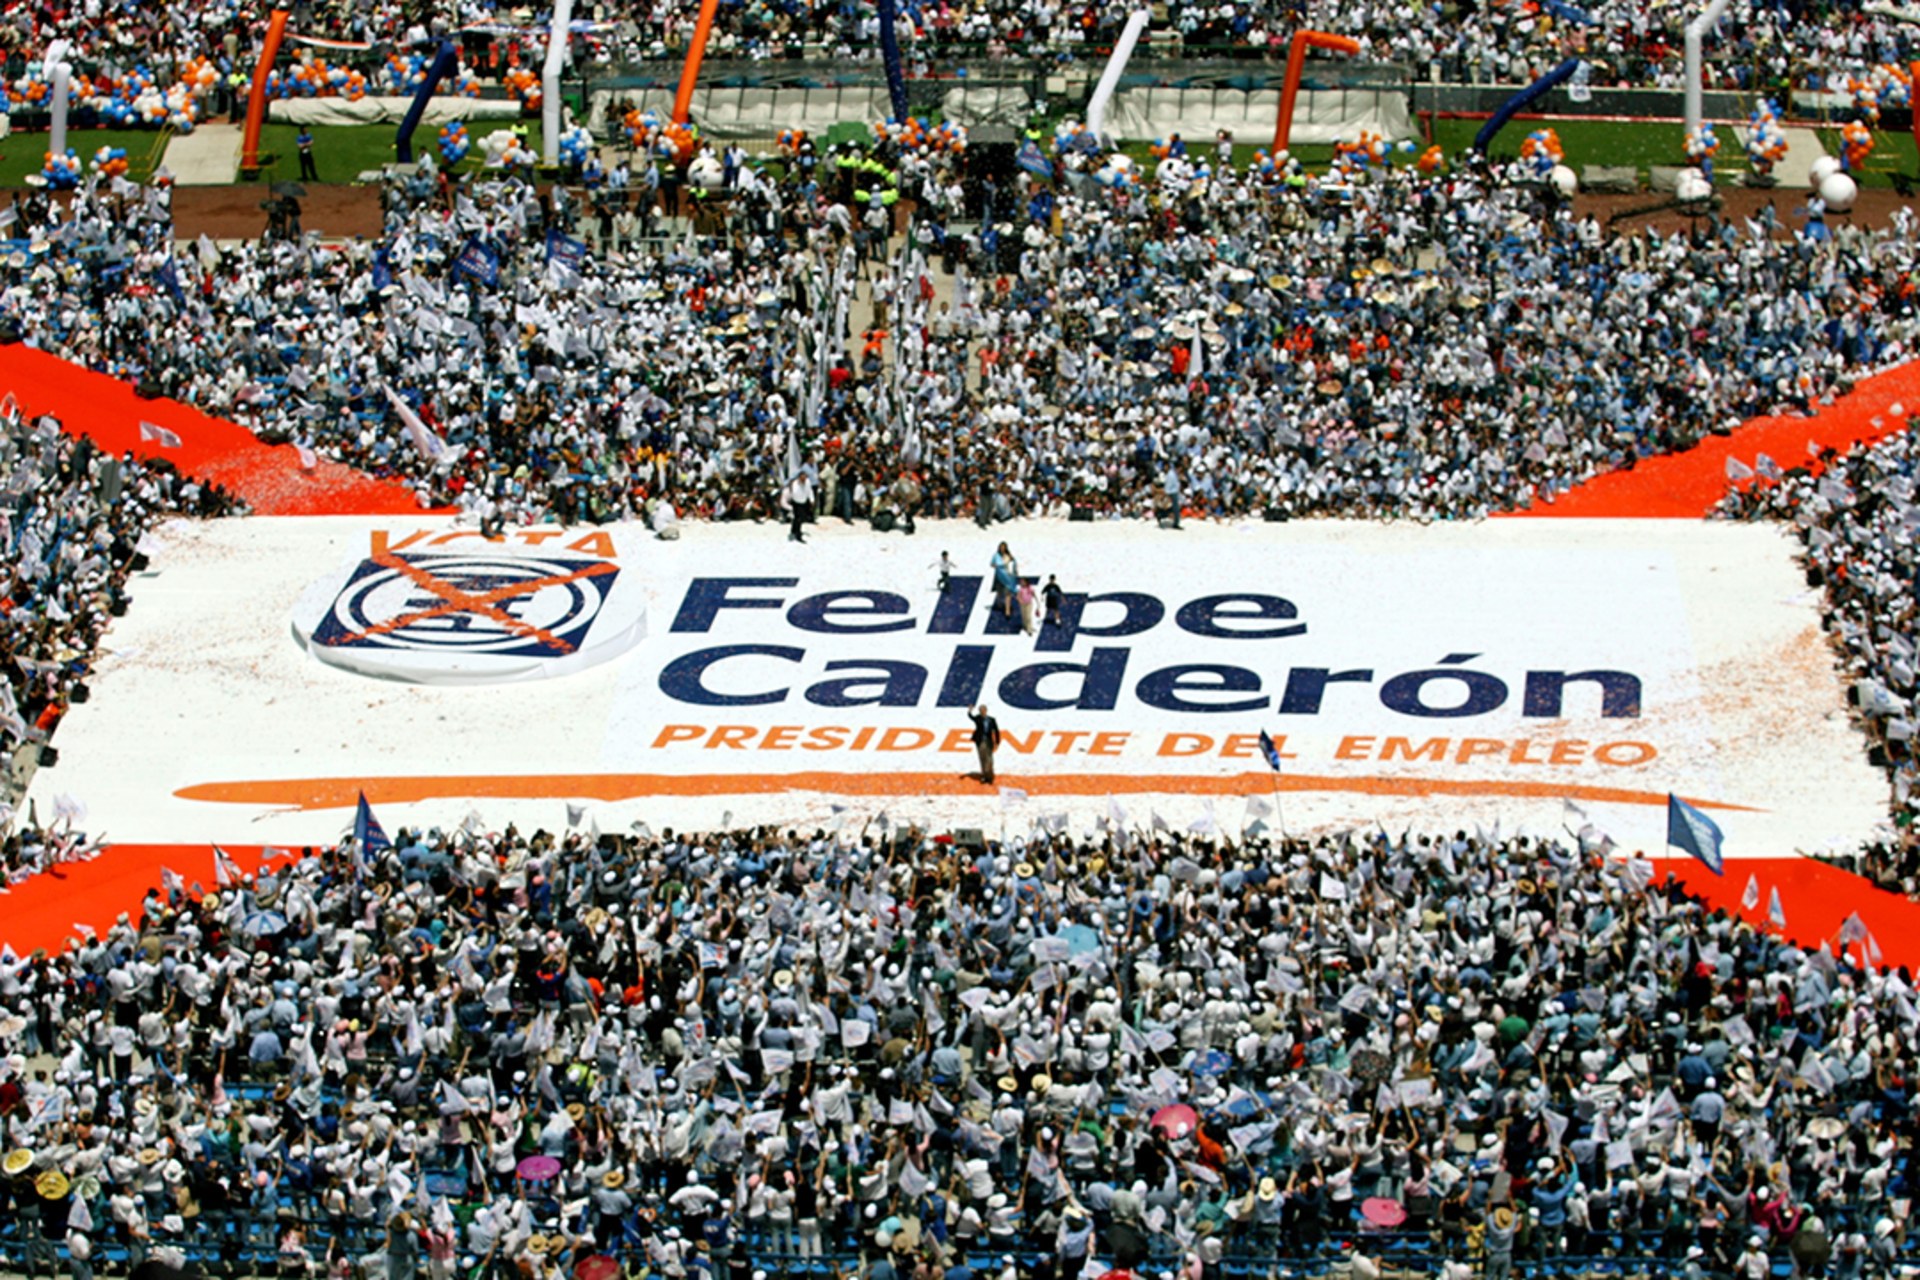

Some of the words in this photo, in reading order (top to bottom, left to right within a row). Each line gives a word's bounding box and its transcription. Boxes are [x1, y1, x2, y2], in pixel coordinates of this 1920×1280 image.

[670, 576, 1307, 652] Felipe
[658, 644, 1642, 718] Calderón
[652, 725, 1131, 756] PRESIDENTE
[1157, 733, 1298, 758] DEL
[1335, 735, 1657, 767] EMPLEO
